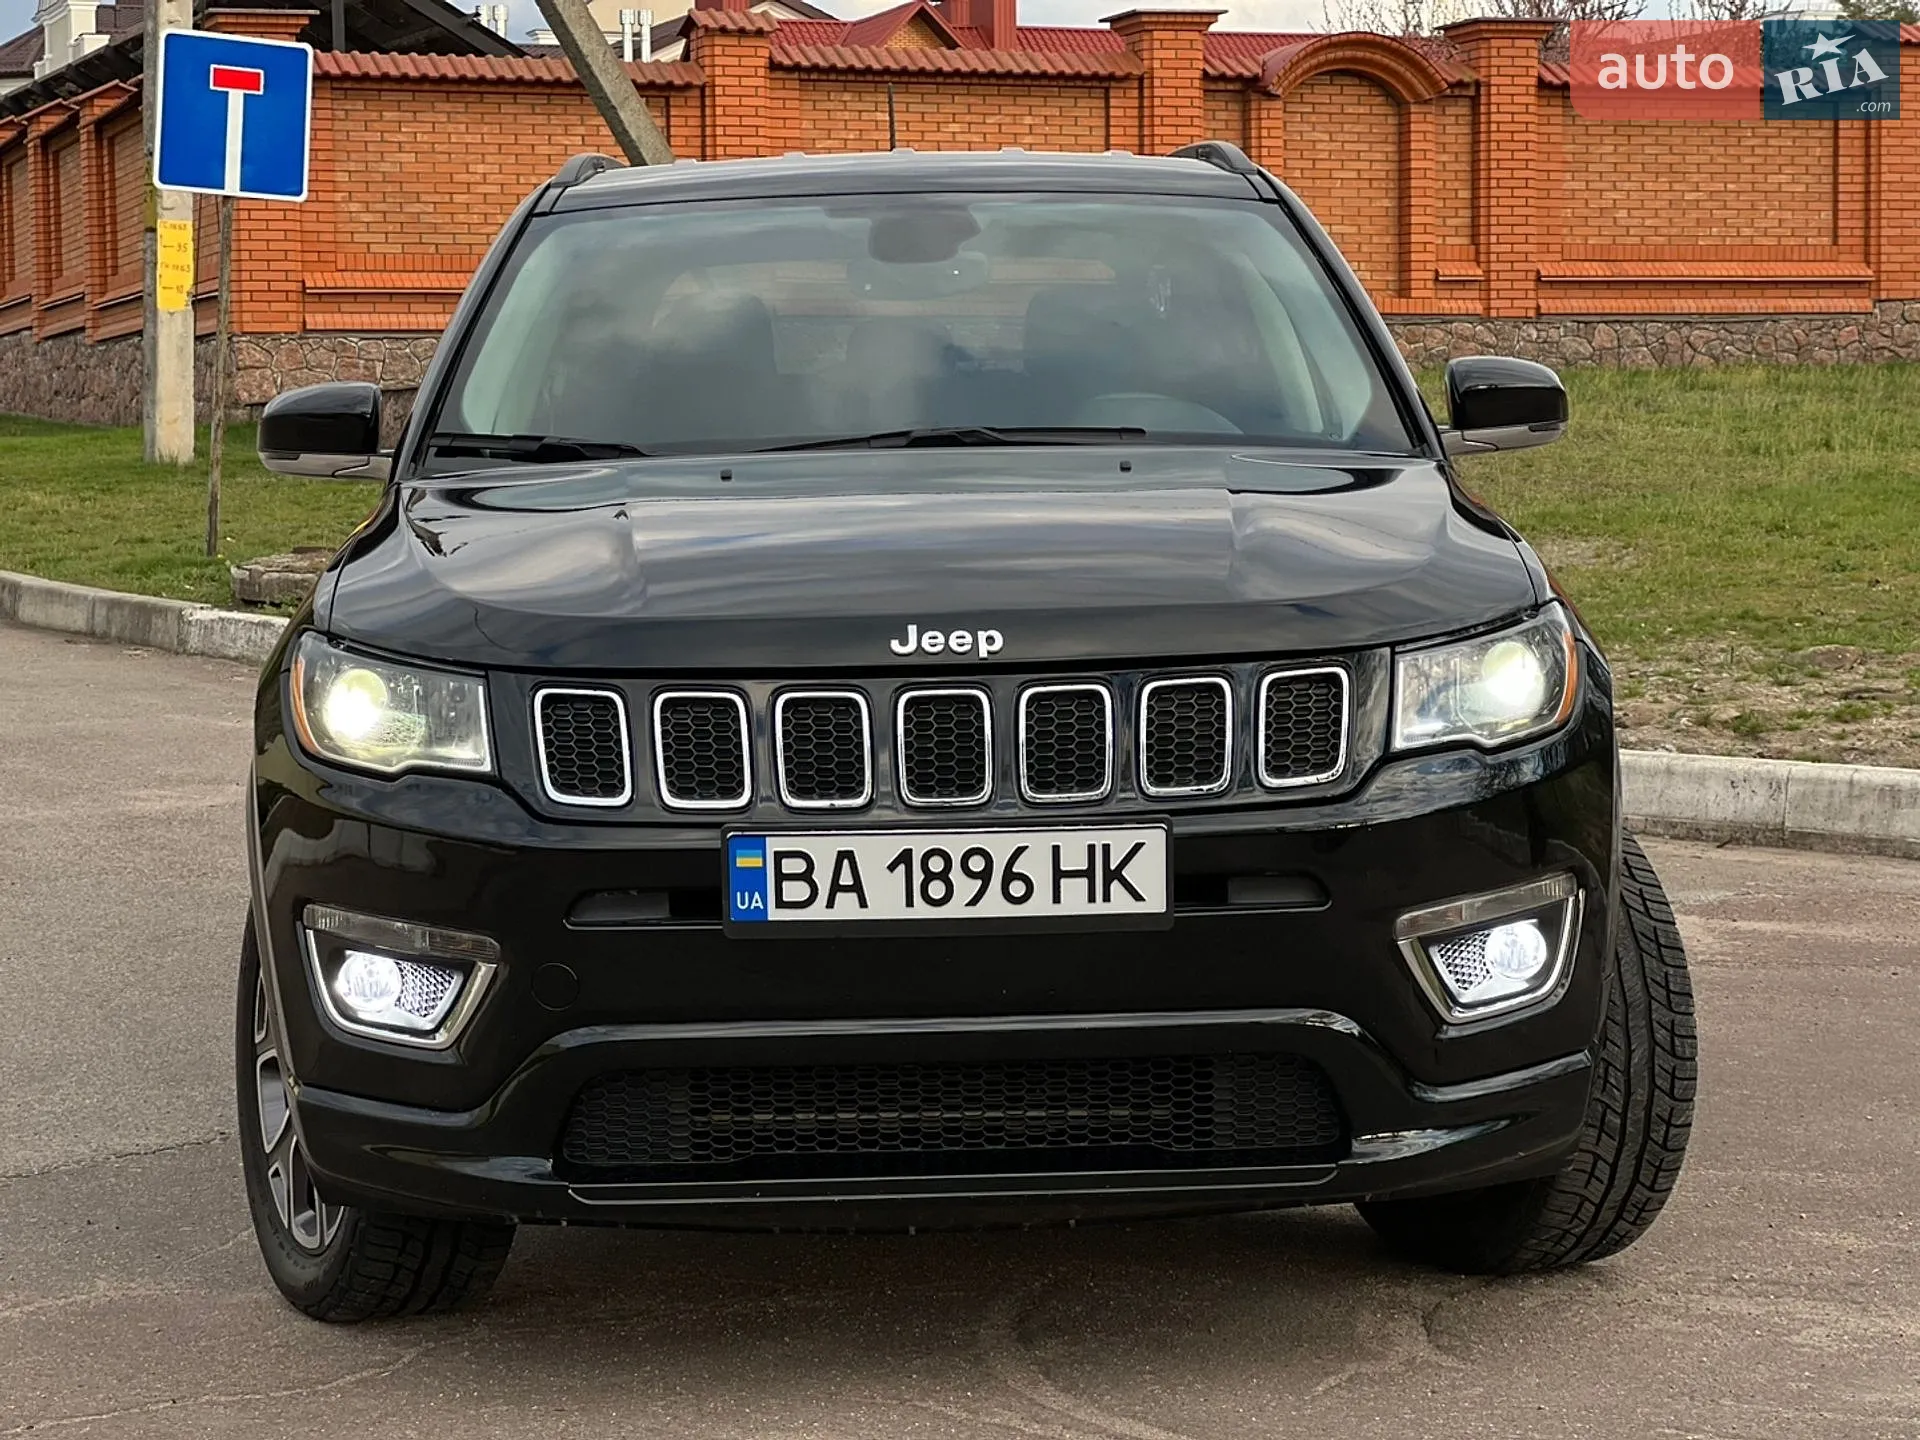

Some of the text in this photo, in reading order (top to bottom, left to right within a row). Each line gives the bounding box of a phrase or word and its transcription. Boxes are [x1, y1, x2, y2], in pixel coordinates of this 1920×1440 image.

[890, 624, 1004, 659] Jeep
[773, 841, 1147, 909] BA 1896 HK
[736, 891, 764, 910] UA
